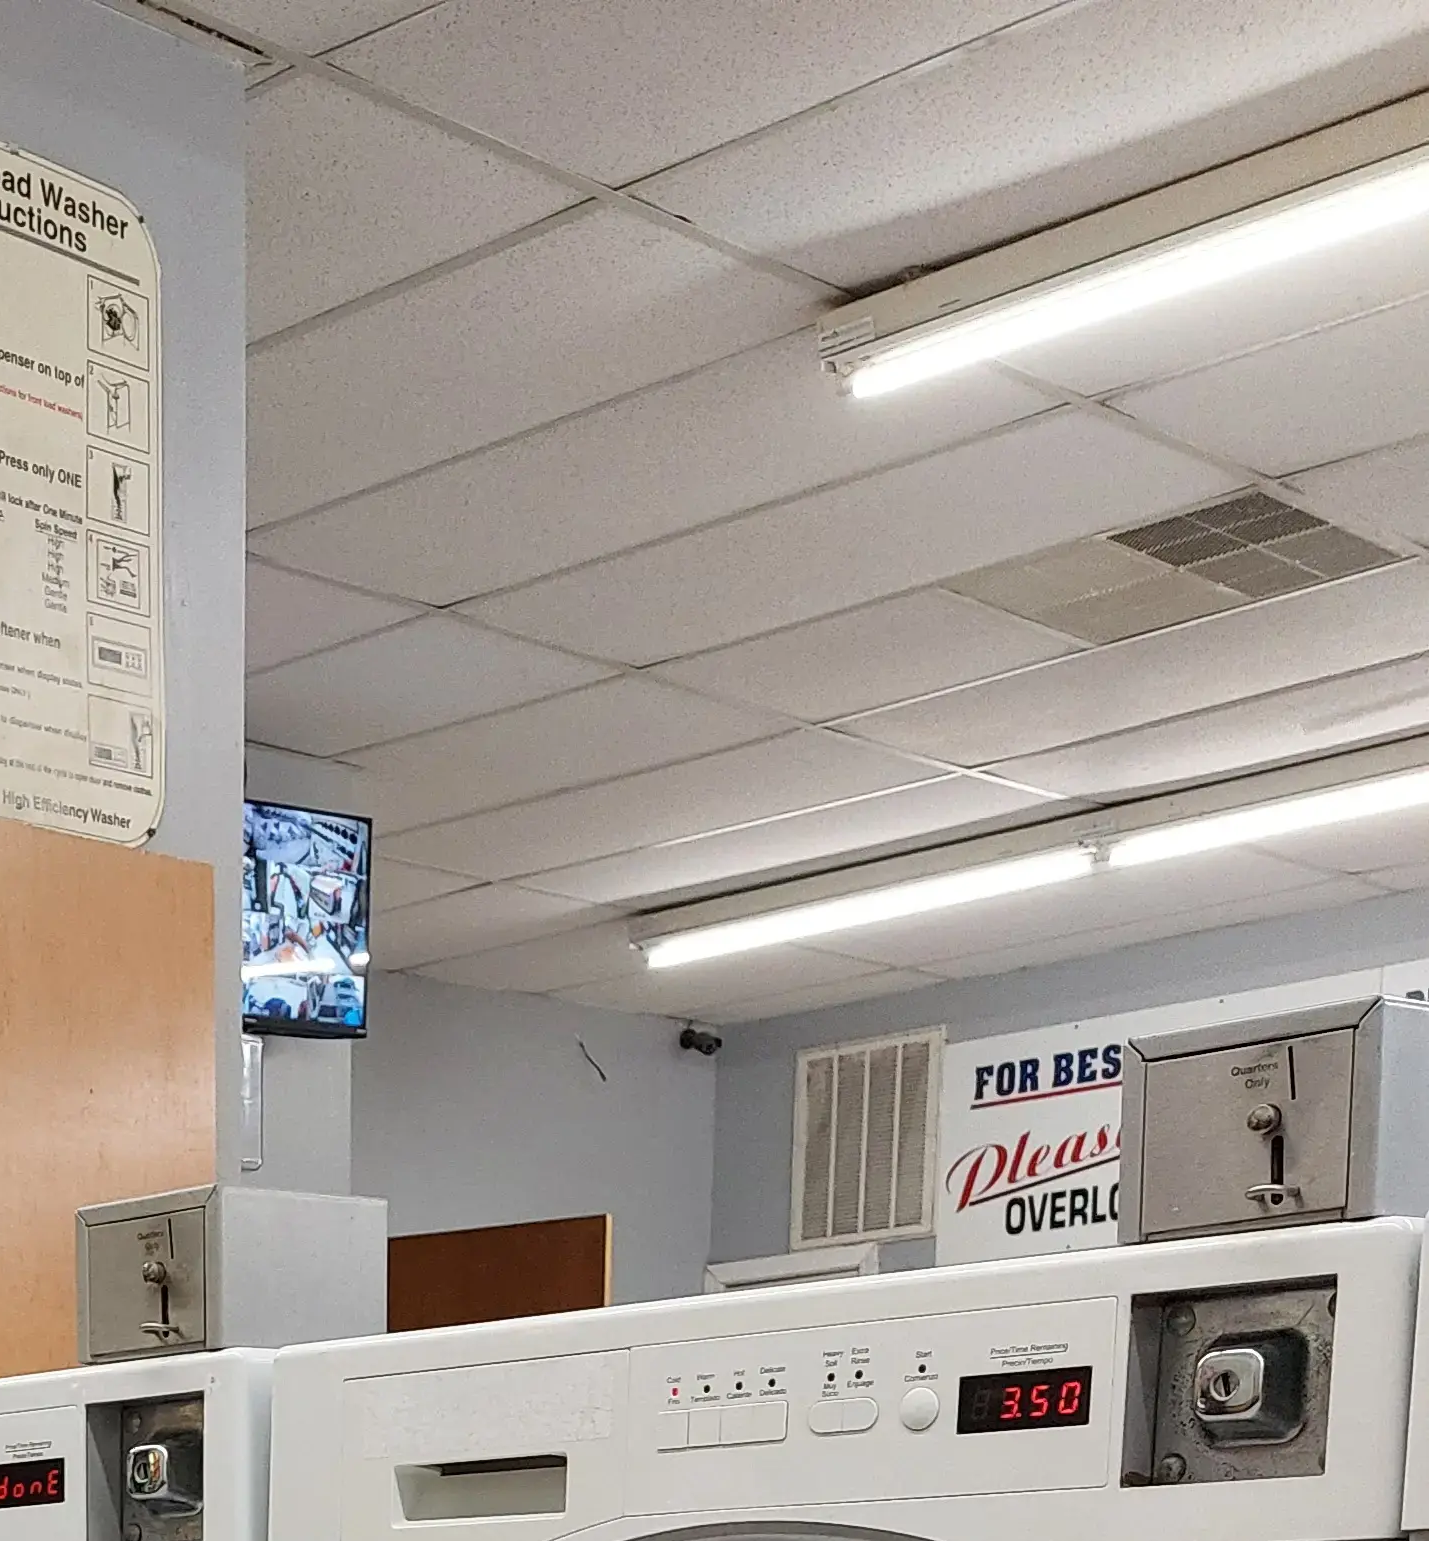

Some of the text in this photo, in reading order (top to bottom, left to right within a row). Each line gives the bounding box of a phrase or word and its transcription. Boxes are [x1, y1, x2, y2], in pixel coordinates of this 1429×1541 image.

[40, 178, 129, 239] Washer
[37, 362, 52, 378] on
[54, 366, 72, 387] top
[74, 374, 85, 389] of
[31, 463, 55, 484] only
[57, 468, 82, 489] ONE
[33, 631, 61, 650] when
[2, 788, 31, 810] High
[33, 795, 90, 824] Efficiency
[90, 807, 131, 830] Washer
[974, 1057, 1040, 1101] FOR
[1230, 1062, 1279, 1077] Quarters
[999, 1381, 1082, 1419] 3.50
